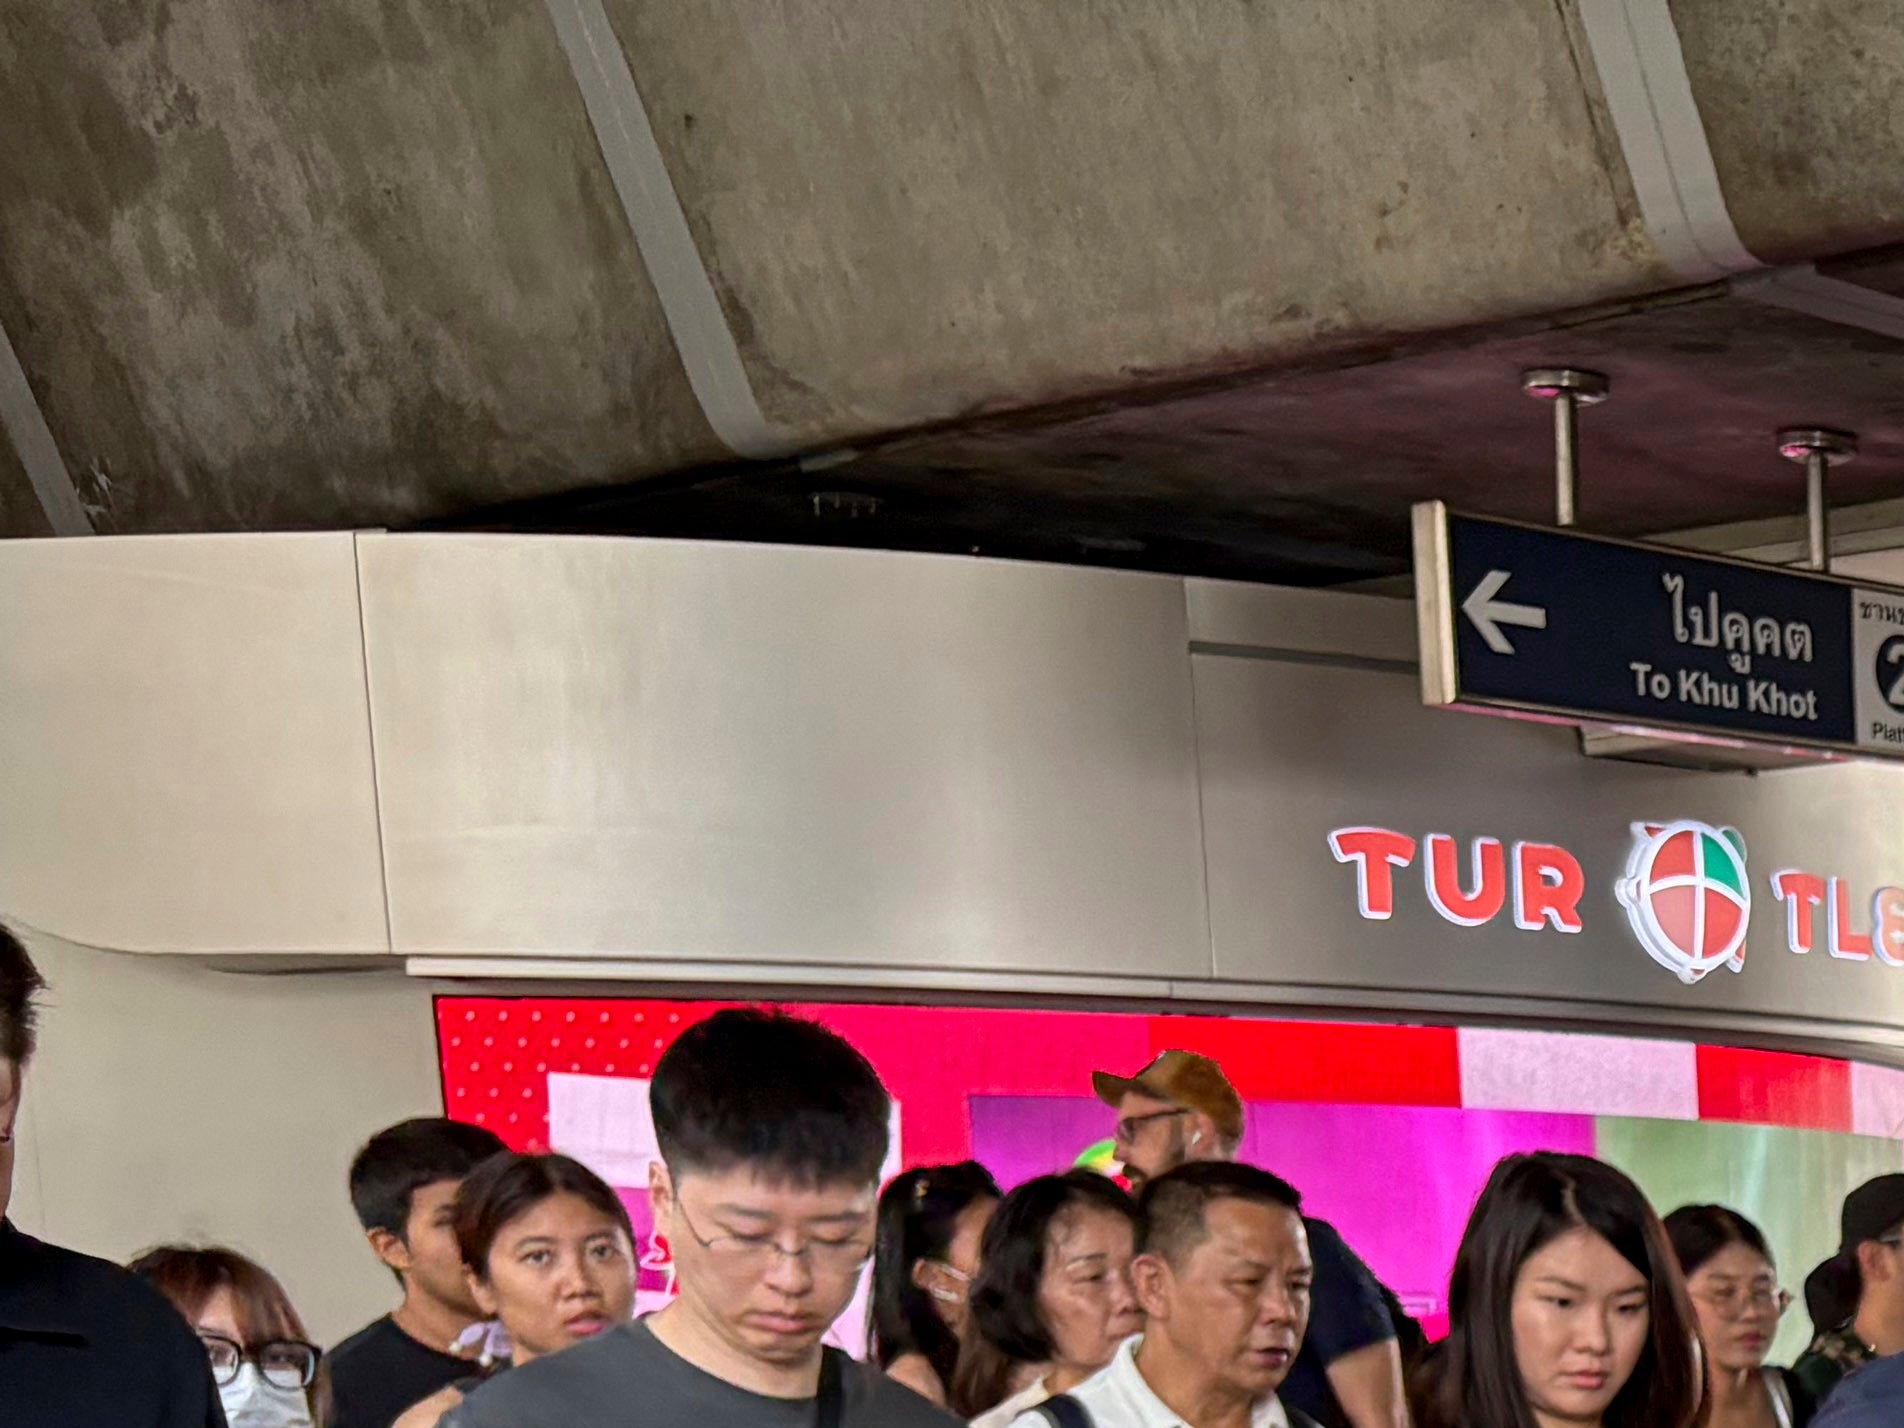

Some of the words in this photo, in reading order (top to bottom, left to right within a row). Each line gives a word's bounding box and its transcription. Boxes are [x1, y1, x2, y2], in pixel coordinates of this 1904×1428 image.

[1662, 572, 1815, 675] ไปคูคต
[1630, 661, 1672, 699] To
[1679, 669, 1740, 710] Khu
[1747, 680, 1819, 721] Khot
[1328, 826, 1586, 933] TUR
